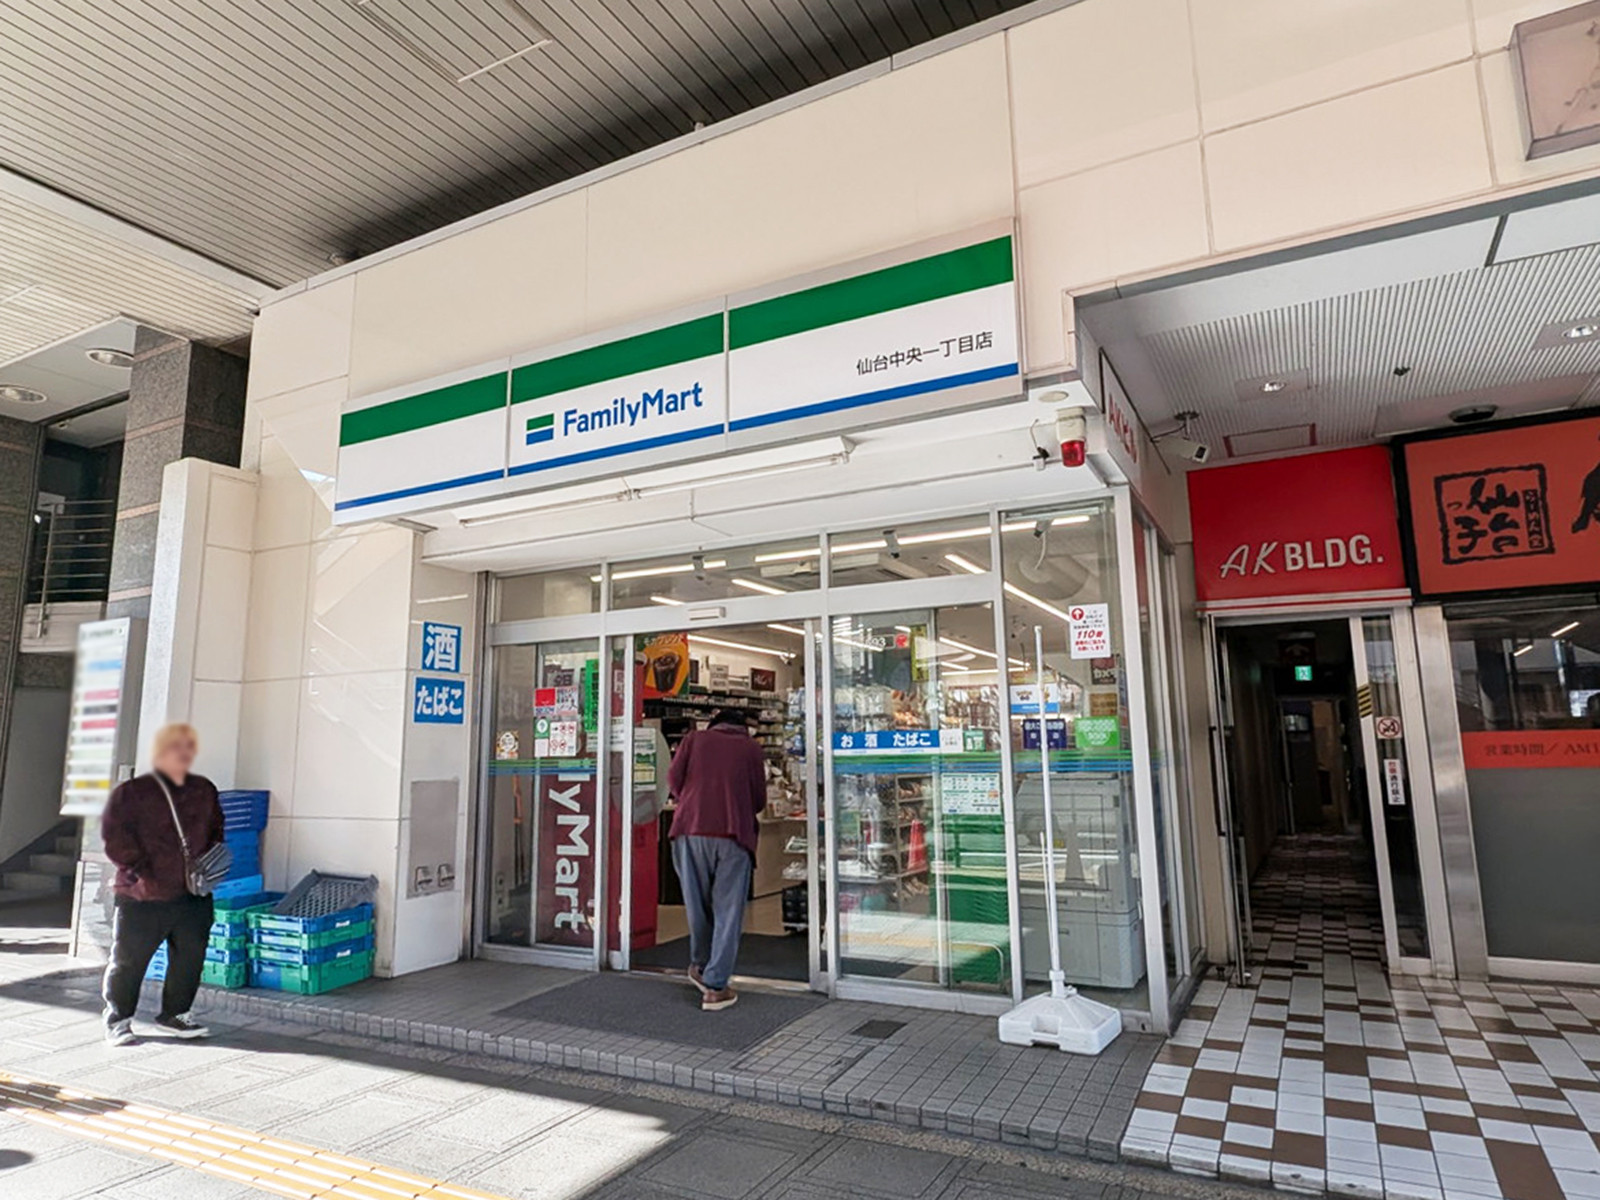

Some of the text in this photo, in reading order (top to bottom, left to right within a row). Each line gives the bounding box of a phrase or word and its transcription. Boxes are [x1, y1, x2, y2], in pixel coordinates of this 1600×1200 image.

[856, 331, 993, 376] 仙台中央一丁目店
[563, 382, 703, 436] FamilyMart
[1219, 534, 1385, 579] AK BLDG.
[424, 624, 459, 671] 酒
[416, 685, 463, 717] たばこ
[893, 732, 931, 747] たばこ
